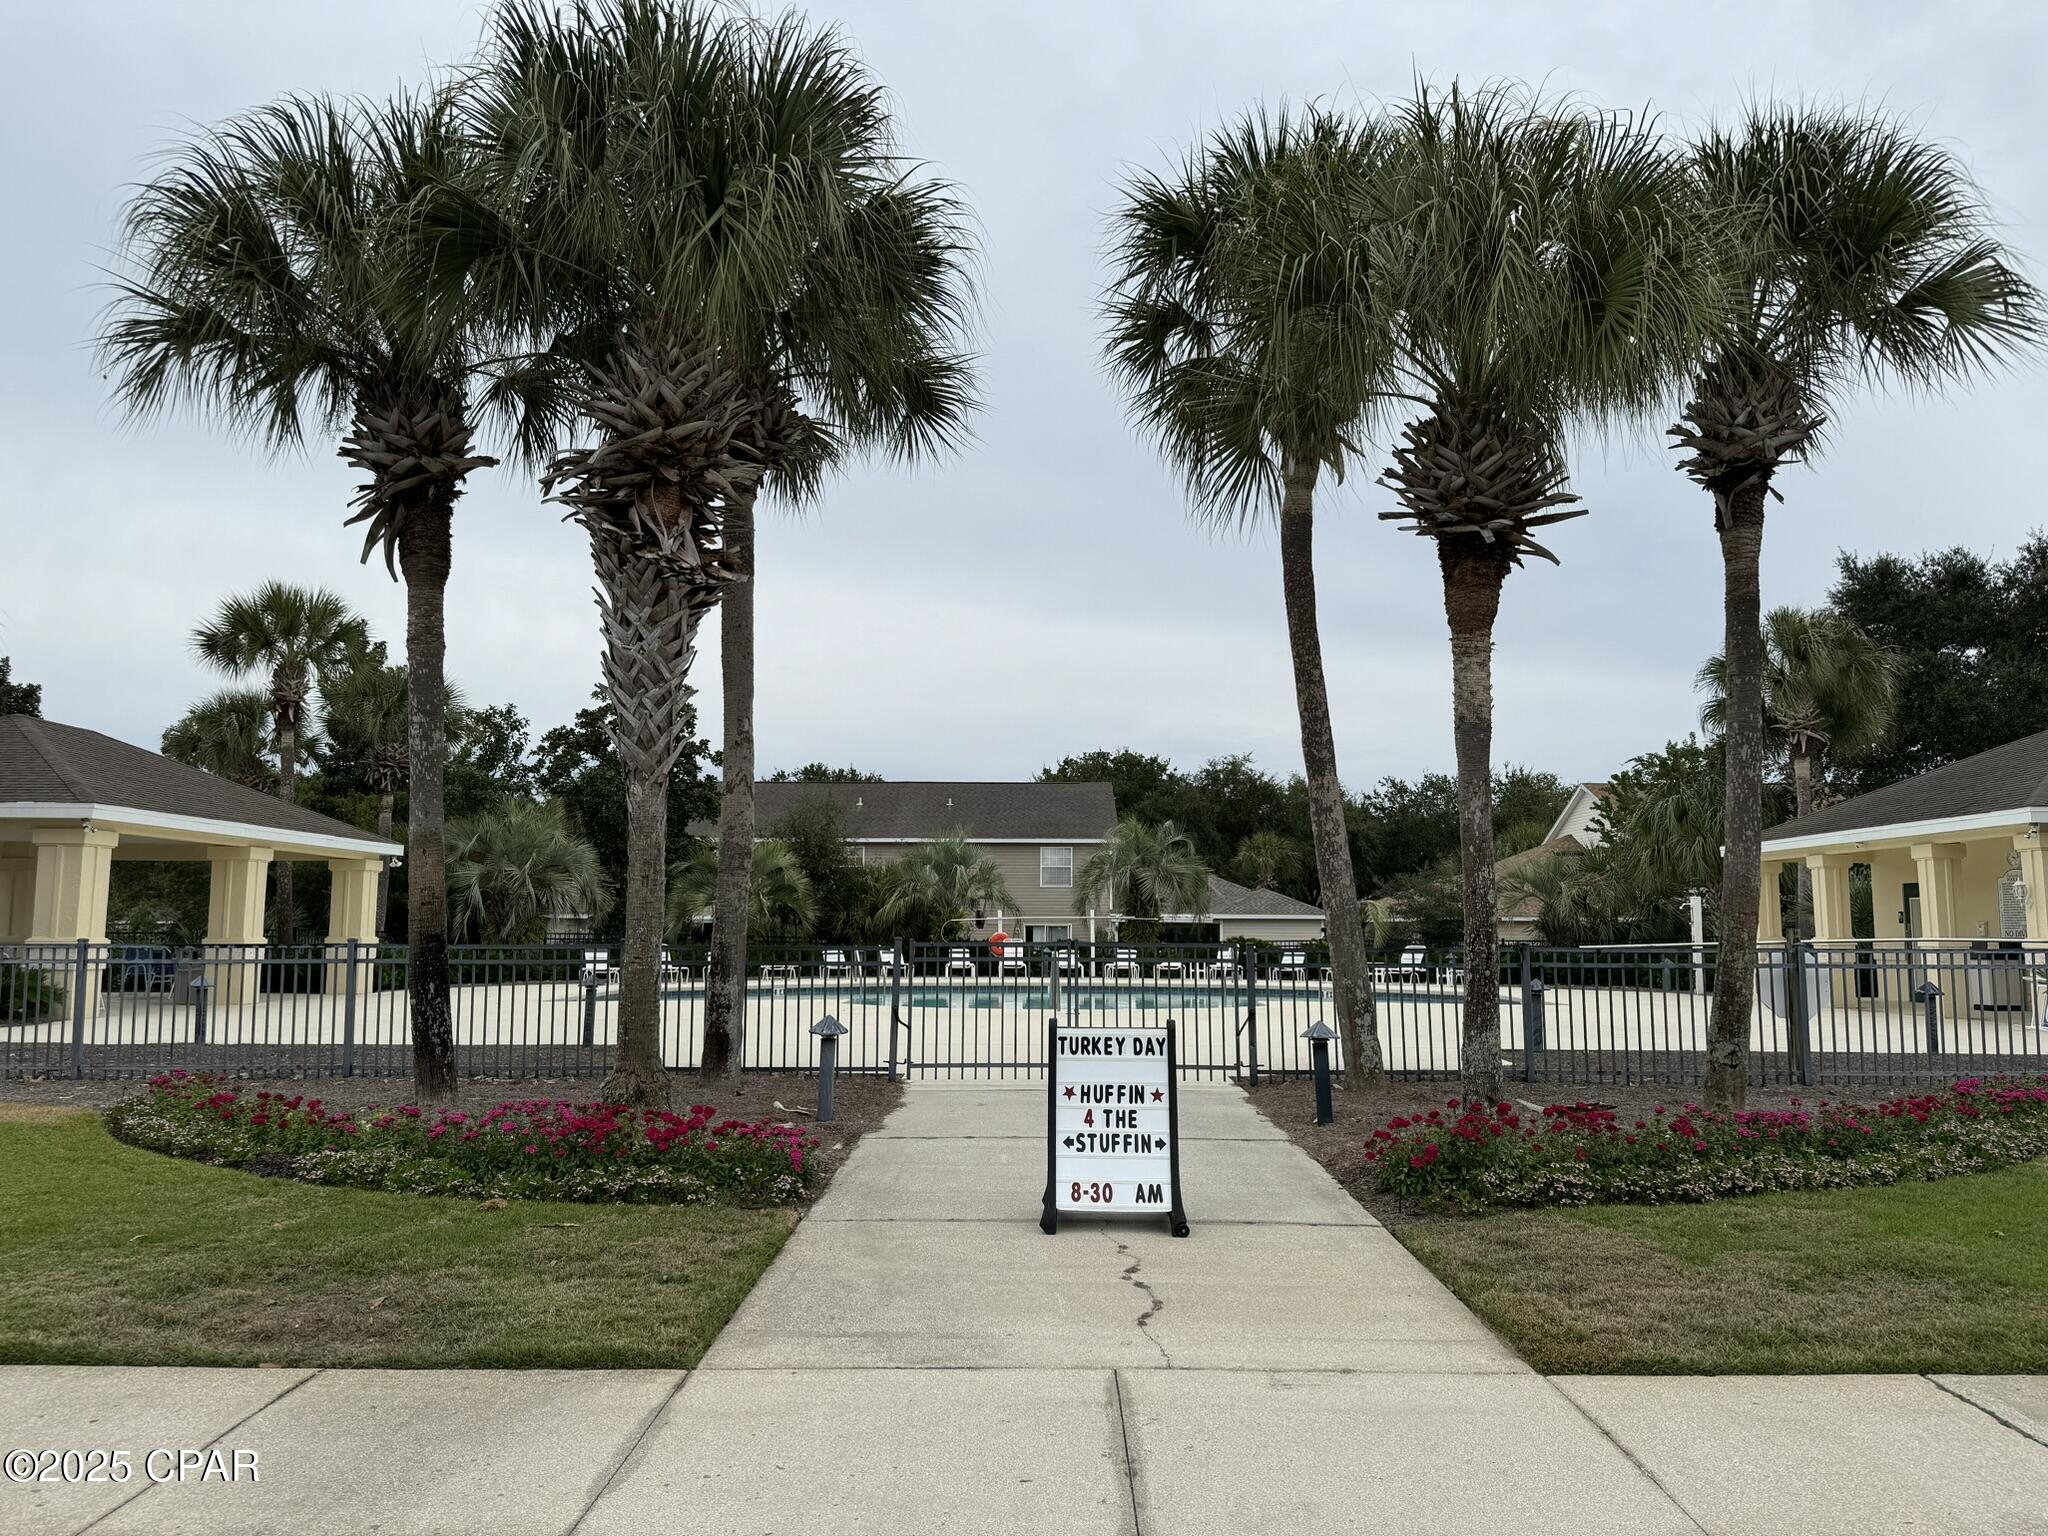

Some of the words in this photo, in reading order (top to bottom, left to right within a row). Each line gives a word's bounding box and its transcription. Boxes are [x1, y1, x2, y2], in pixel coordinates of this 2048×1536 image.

[1056, 1035, 1126, 1056] TURKEY
[1132, 1036, 1167, 1057] DAY
[1080, 1083, 1145, 1105] HUFFIN
[1083, 1108, 1095, 1129] 4
[1102, 1109, 1138, 1129] THE
[1075, 1132, 1152, 1154] STUFFIN
[1070, 1182, 1113, 1204] 8-30
[1135, 1183, 1164, 1204] AM
